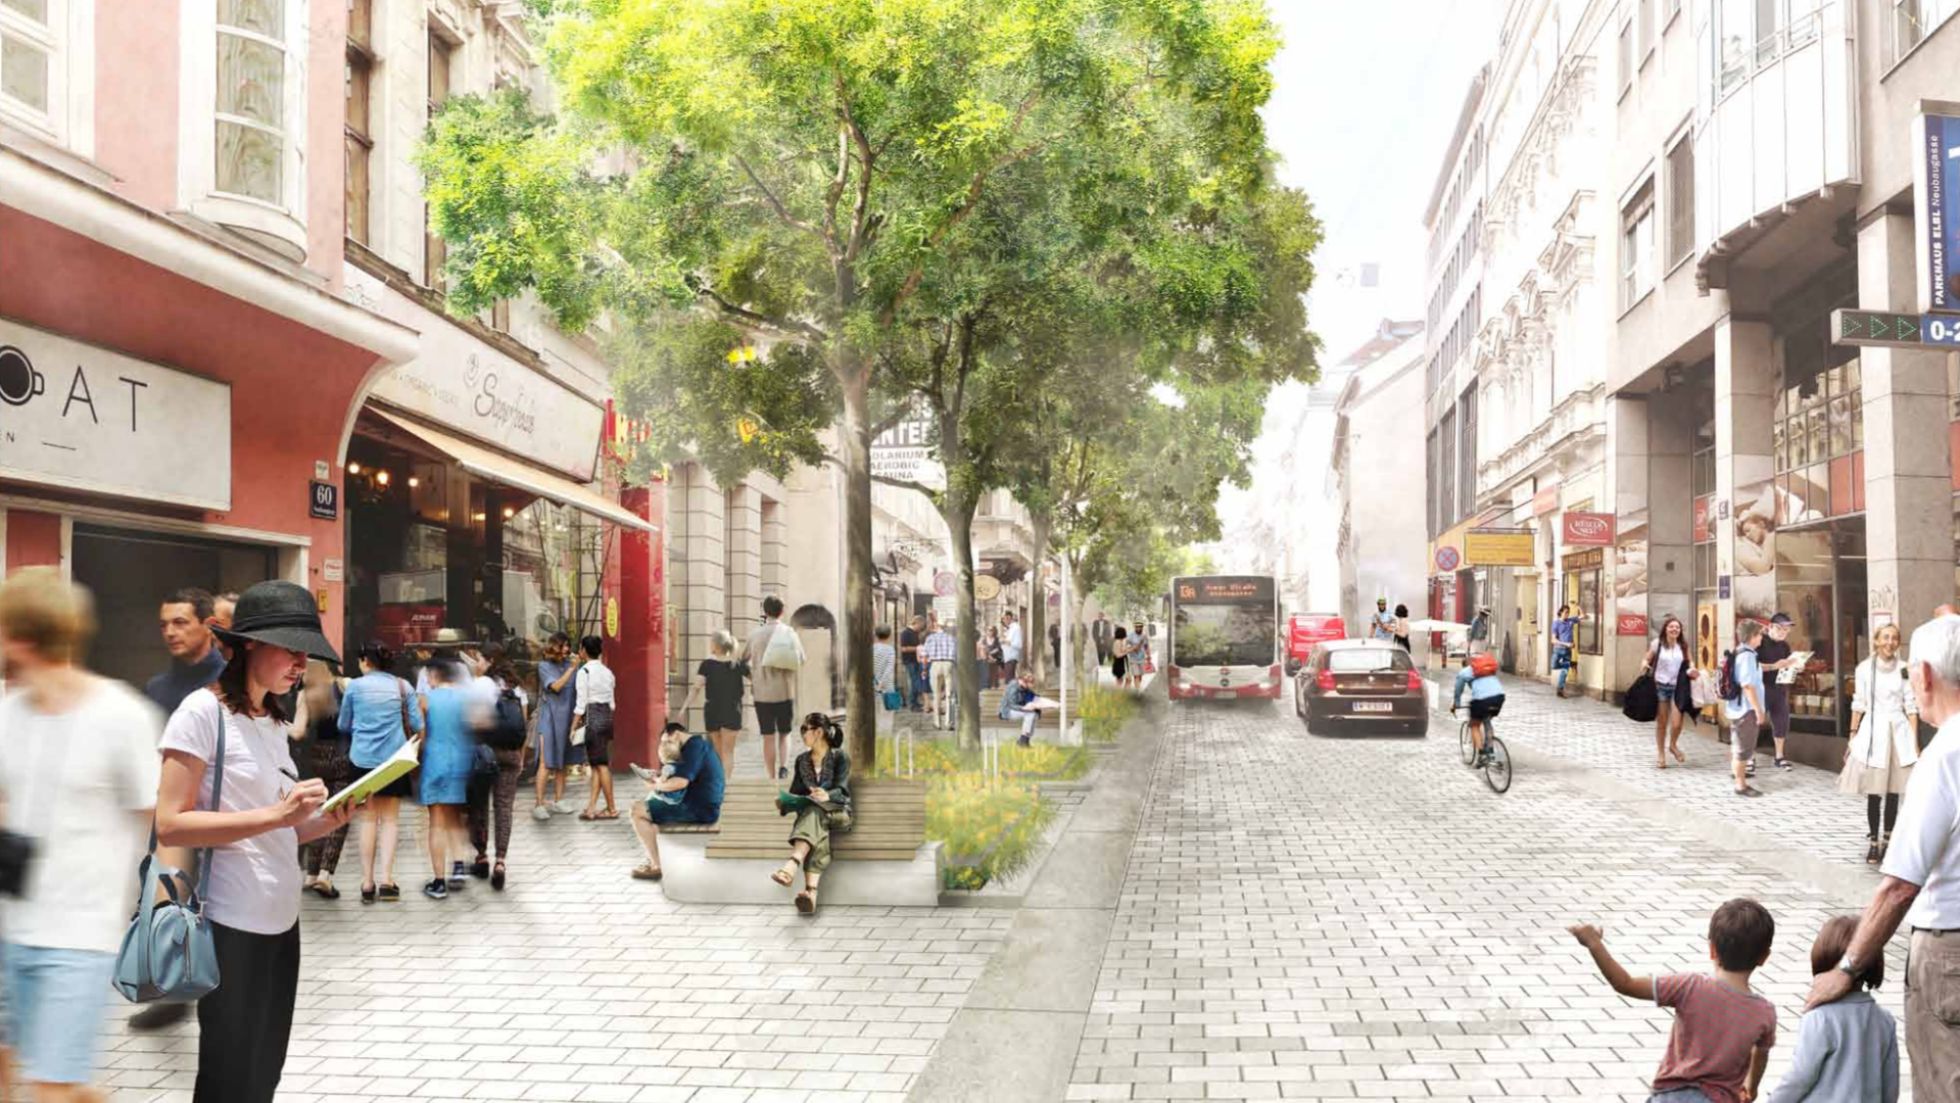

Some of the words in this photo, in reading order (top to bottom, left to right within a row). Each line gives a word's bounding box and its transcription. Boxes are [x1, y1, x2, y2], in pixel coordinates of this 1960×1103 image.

[1930, 134, 1941, 207] Neubaugasse
[1933, 242, 1944, 305] PARKHAUS
[871, 450, 925, 460] OLARIUM
[316, 485, 333, 505] 60
